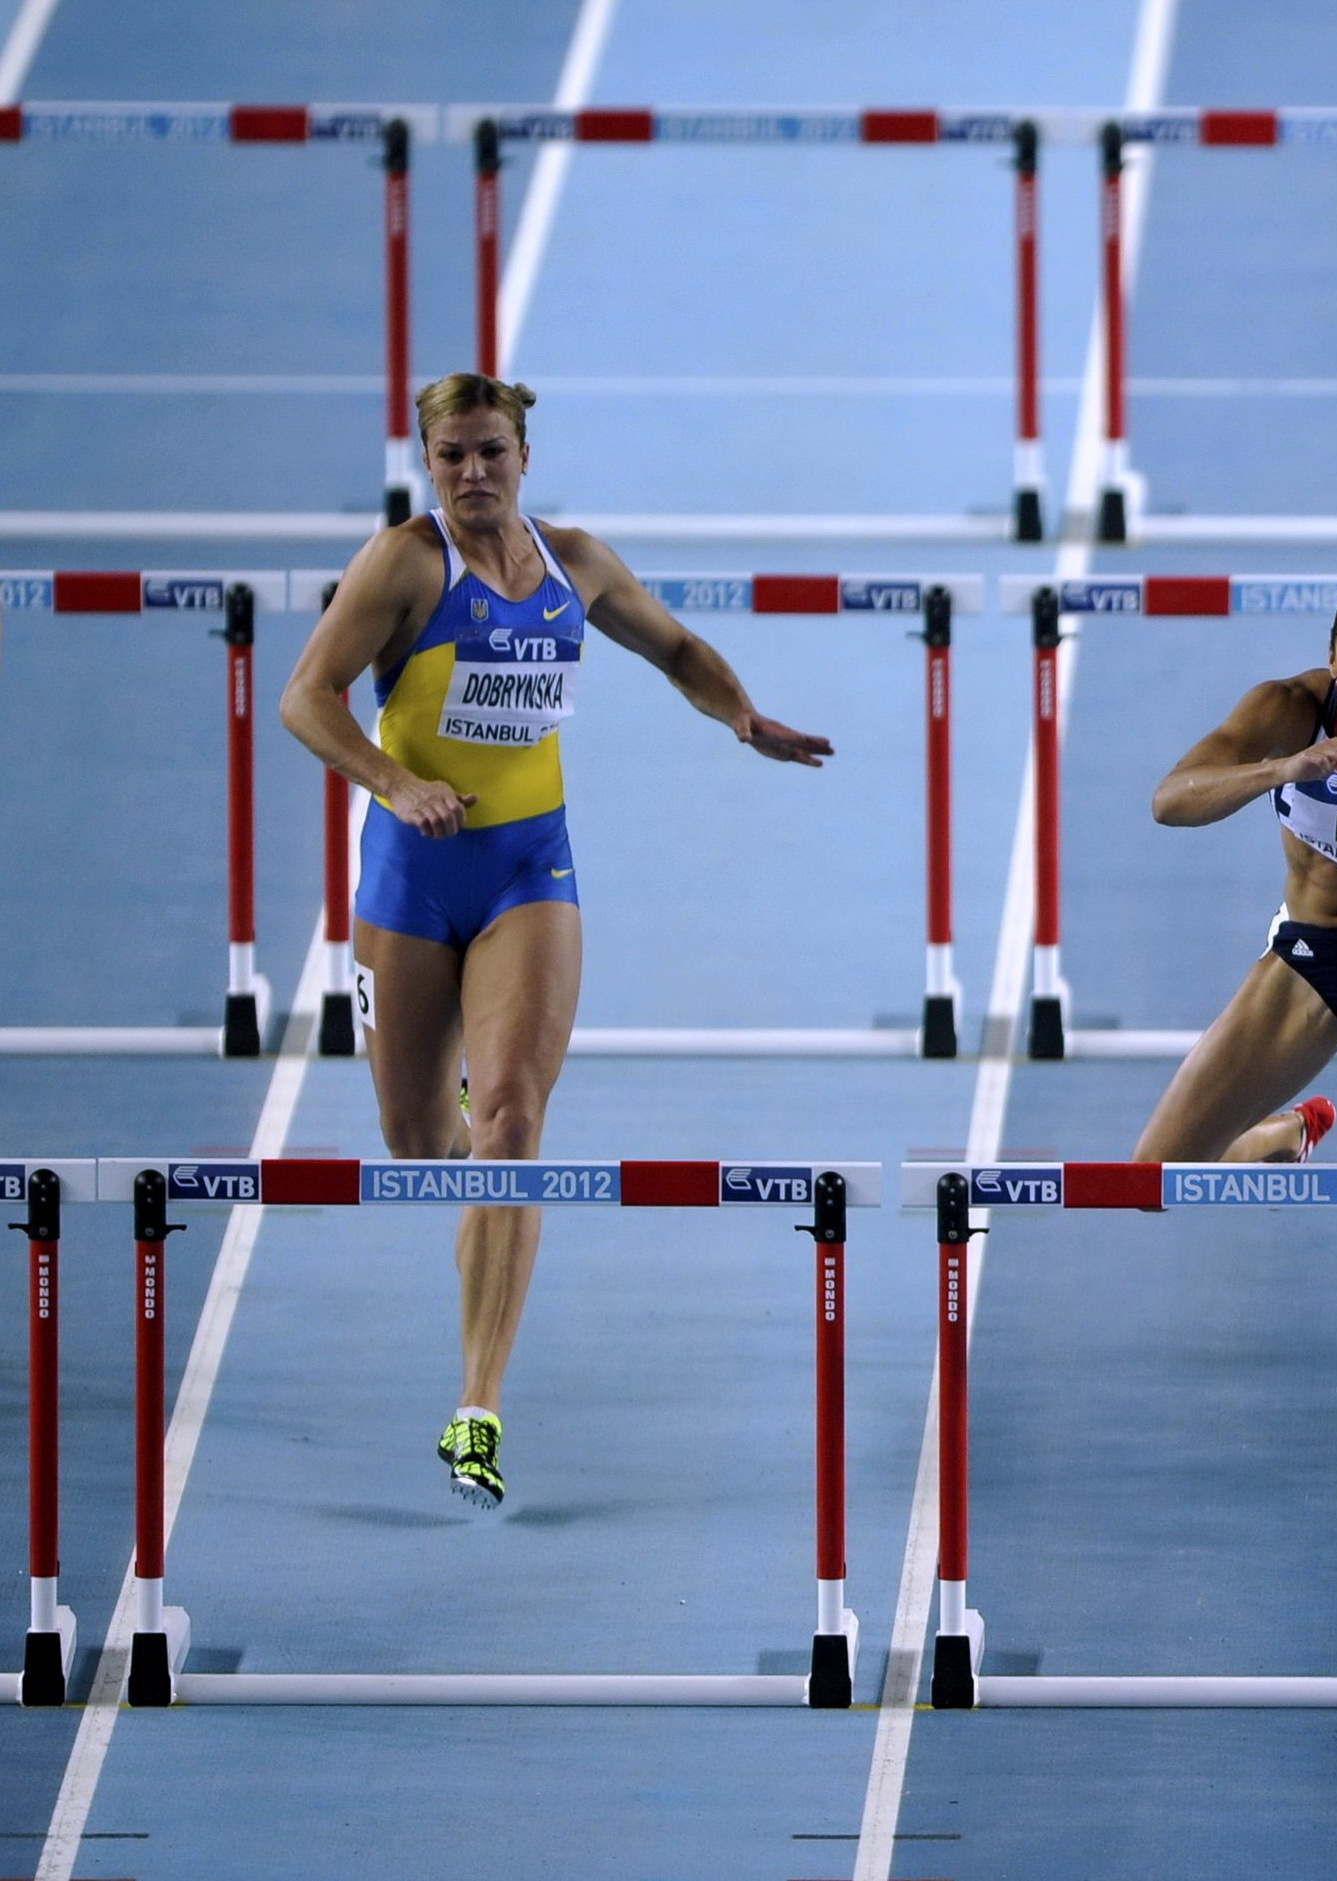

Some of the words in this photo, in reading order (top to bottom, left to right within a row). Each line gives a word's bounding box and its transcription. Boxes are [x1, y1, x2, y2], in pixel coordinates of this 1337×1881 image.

[174, 586, 220, 608] VTB
[683, 581, 743, 607] 2012
[870, 588, 918, 610] VTB
[1089, 588, 1139, 610] VTB
[515, 638, 557, 660] VTB
[462, 673, 563, 710] DOBRYNSKA
[445, 718, 534, 743] ISTANBUL
[203, 1176, 255, 1198] VTB
[373, 1171, 528, 1198] ISTANBUL
[542, 1171, 613, 1198] 2012
[757, 1179, 808, 1201] VTB
[1006, 1180, 1058, 1202] VTB
[1174, 1174, 1329, 1202] ISTANBUL
[39, 1267, 49, 1319] MONDO
[145, 1267, 155, 1319] MONDO
[825, 1269, 835, 1321] MONDO
[948, 1270, 958, 1322] MONDO
